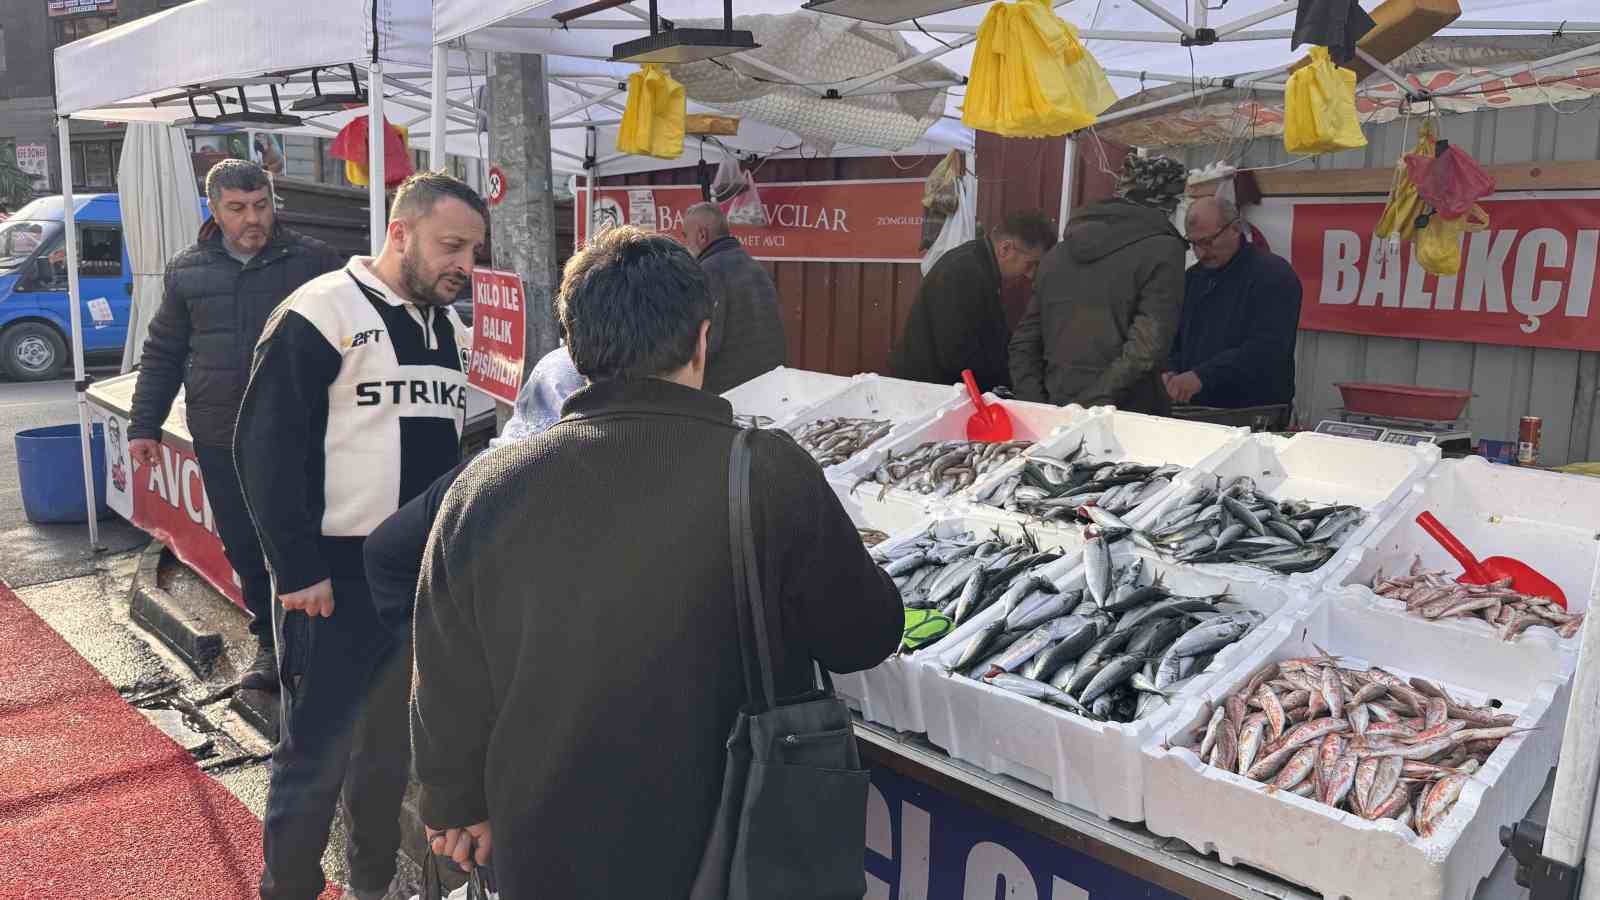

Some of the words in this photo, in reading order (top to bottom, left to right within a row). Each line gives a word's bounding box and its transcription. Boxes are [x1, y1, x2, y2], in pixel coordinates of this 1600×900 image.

[761, 204, 849, 232] VCILAR
[477, 278, 500, 307] KİLO
[502, 279, 519, 311] İLE
[482, 315, 513, 344] BALIK
